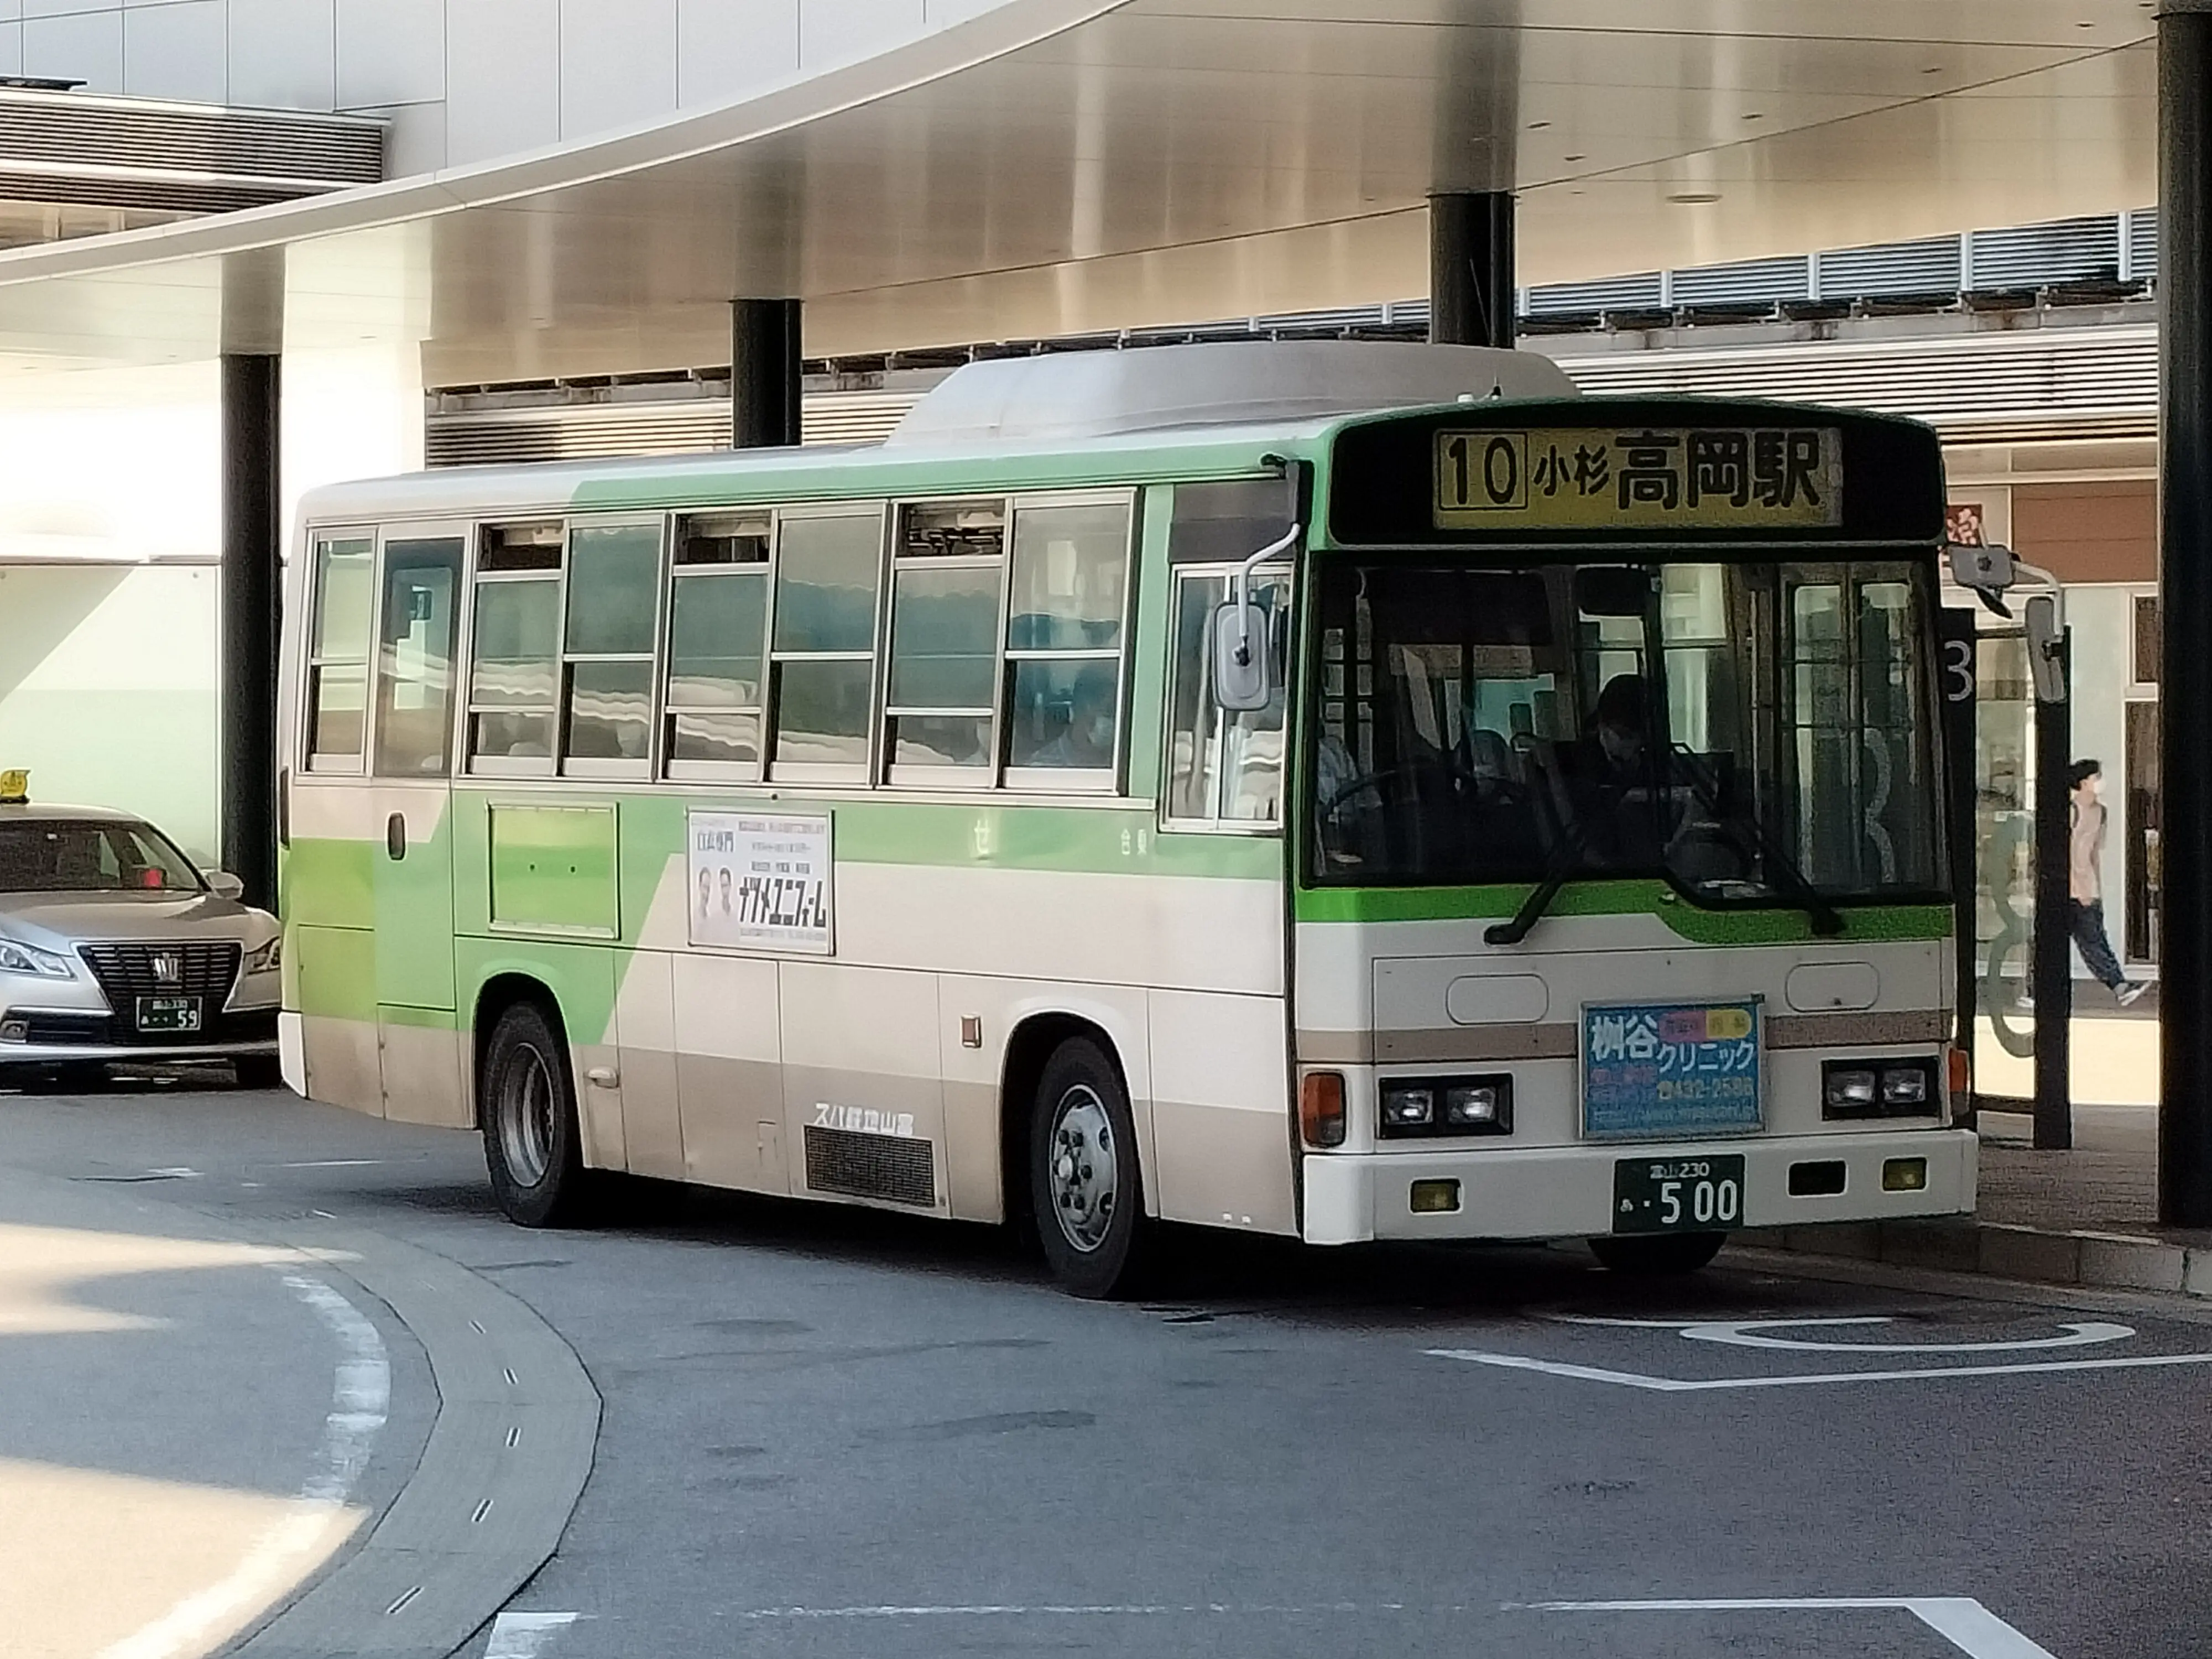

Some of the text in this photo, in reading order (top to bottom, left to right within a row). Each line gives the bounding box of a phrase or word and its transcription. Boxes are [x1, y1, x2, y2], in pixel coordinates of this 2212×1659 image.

[1448, 430, 1821, 509] 10 小杉 高岡駅
[1944, 640, 1973, 701] 3
[178, 1010, 197, 1027] 59
[1657, 1040, 1755, 1074] クリニック
[1679, 1162, 1710, 1178] 230
